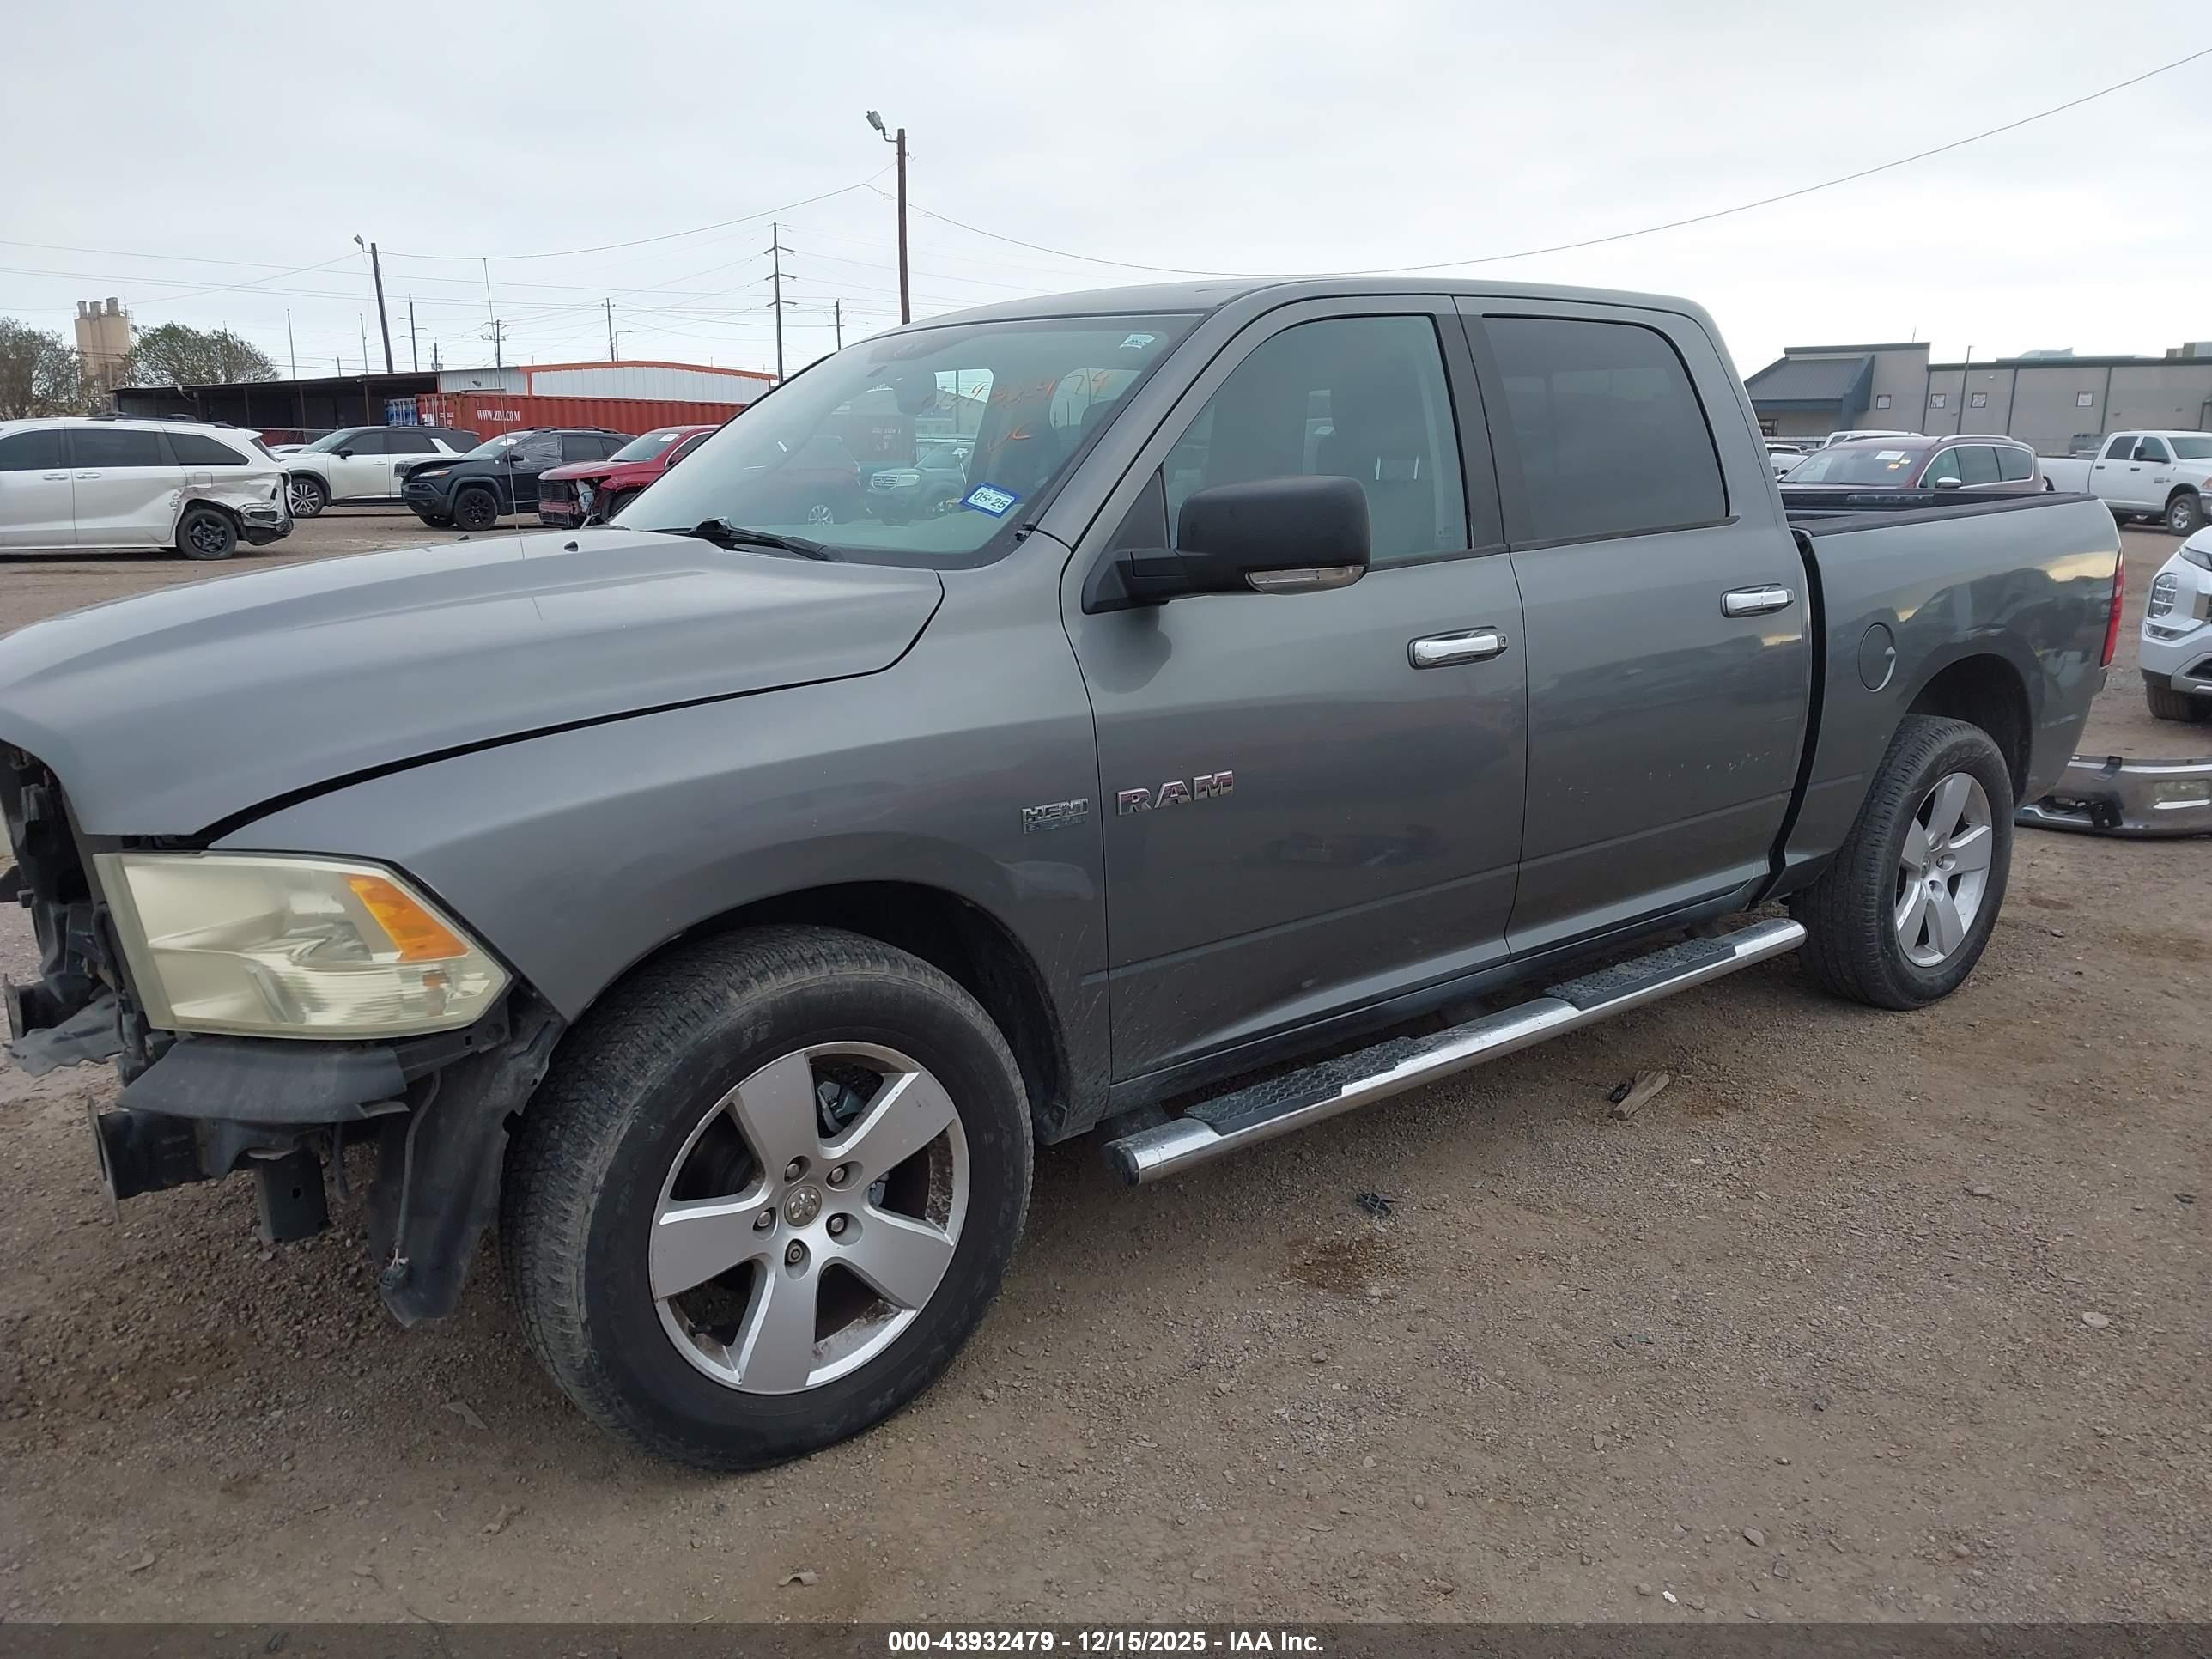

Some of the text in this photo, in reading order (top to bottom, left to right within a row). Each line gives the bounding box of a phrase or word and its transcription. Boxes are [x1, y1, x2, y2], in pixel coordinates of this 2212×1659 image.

[990, 498, 1009, 509] 25
[1117, 770, 1234, 816] RAM
[1022, 798, 1089, 823] HEMI
